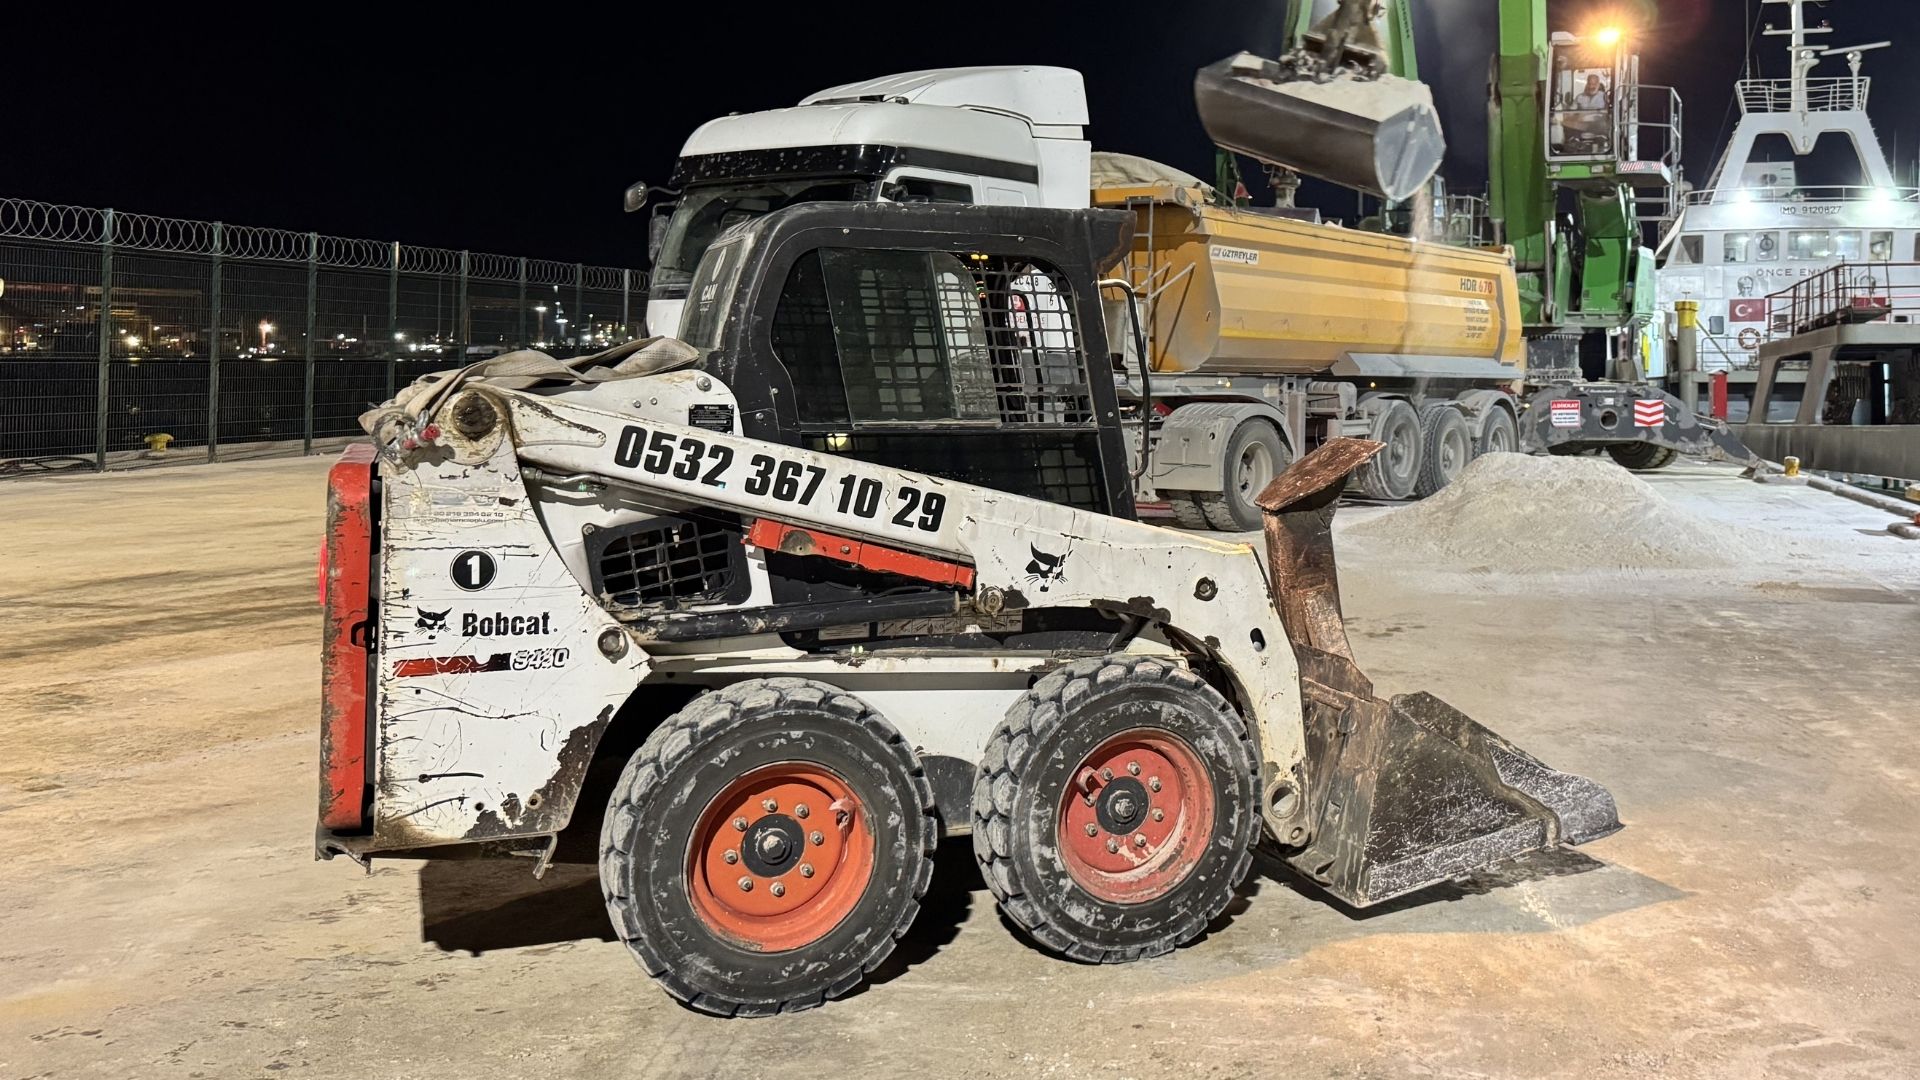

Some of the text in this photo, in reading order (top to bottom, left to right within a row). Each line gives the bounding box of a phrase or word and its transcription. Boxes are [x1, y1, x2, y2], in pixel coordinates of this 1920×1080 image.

[1460, 277, 1493, 294] HDR 670
[614, 424, 947, 533] 0532 367 10 29
[467, 555, 480, 585] 1
[462, 611, 551, 637] Bobcat
